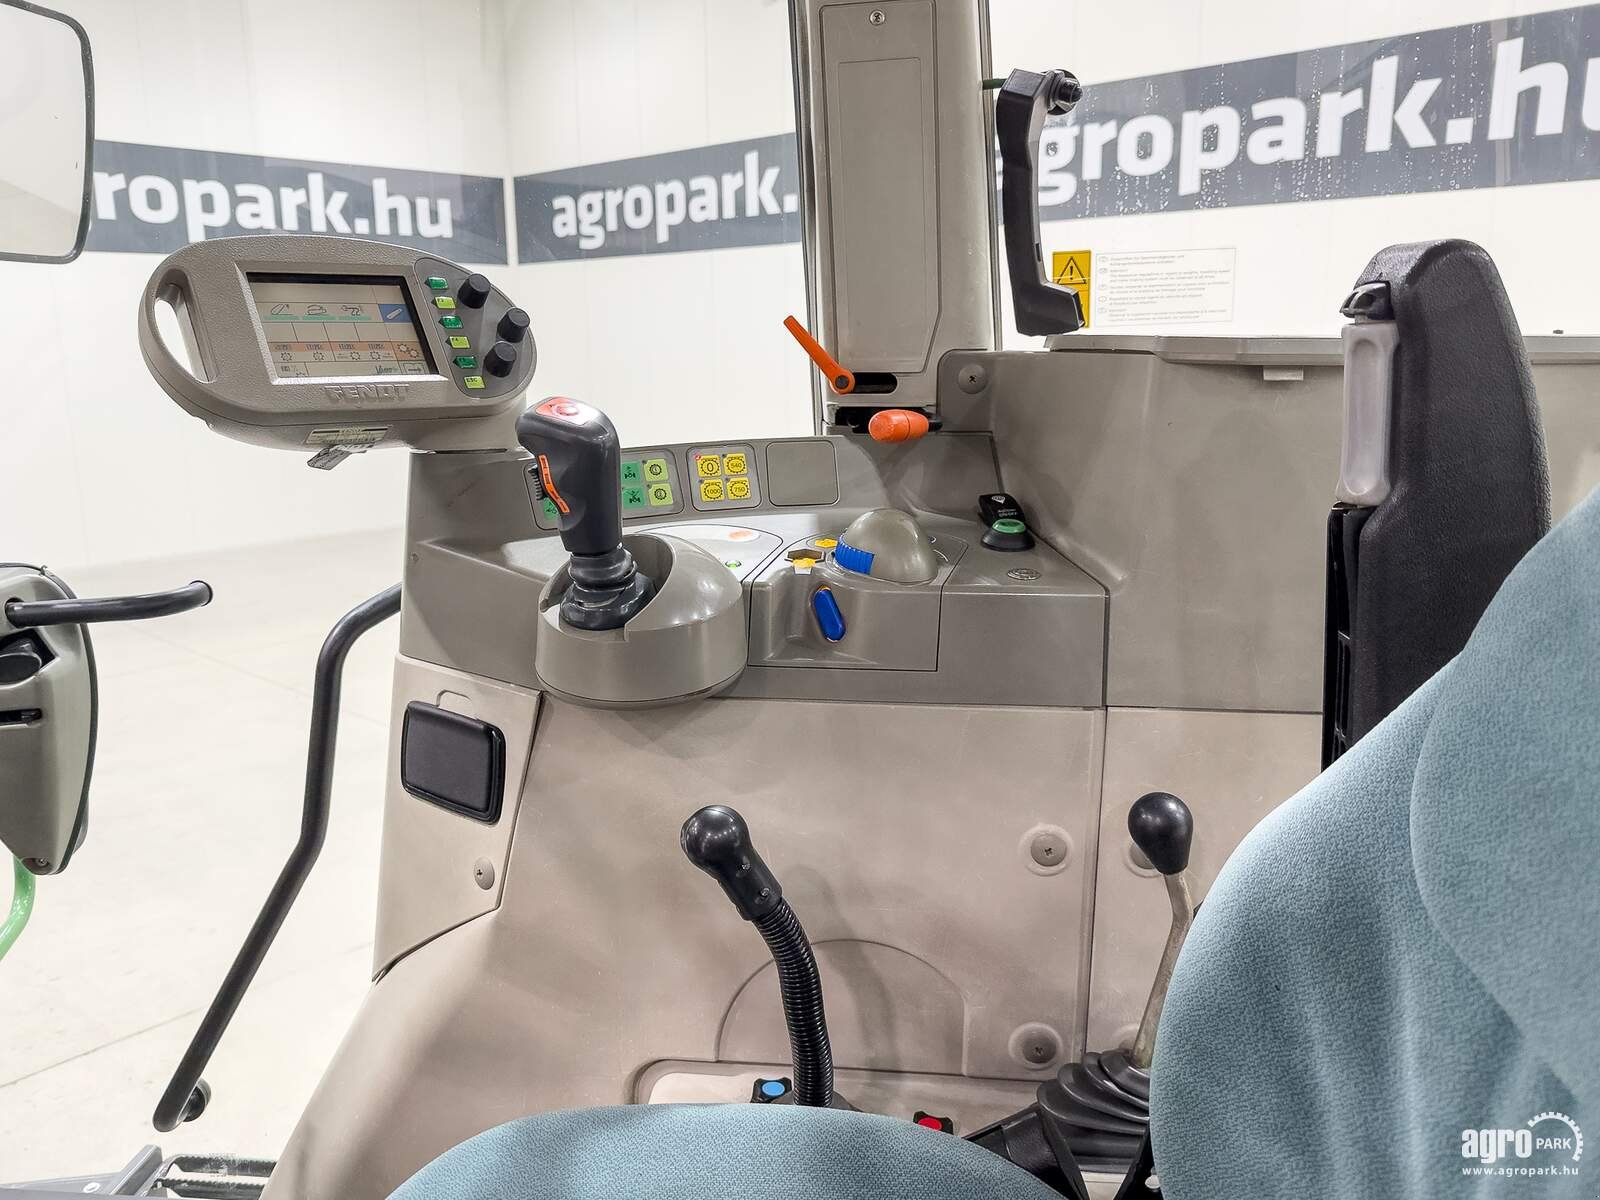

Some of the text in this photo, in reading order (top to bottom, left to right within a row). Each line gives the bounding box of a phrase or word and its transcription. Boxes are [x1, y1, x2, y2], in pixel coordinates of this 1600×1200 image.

[1038, 36, 1600, 207] gropark.h
[90, 171, 454, 244] ropark.hu
[552, 150, 799, 250] agropark.
[323, 383, 410, 403] FENDT
